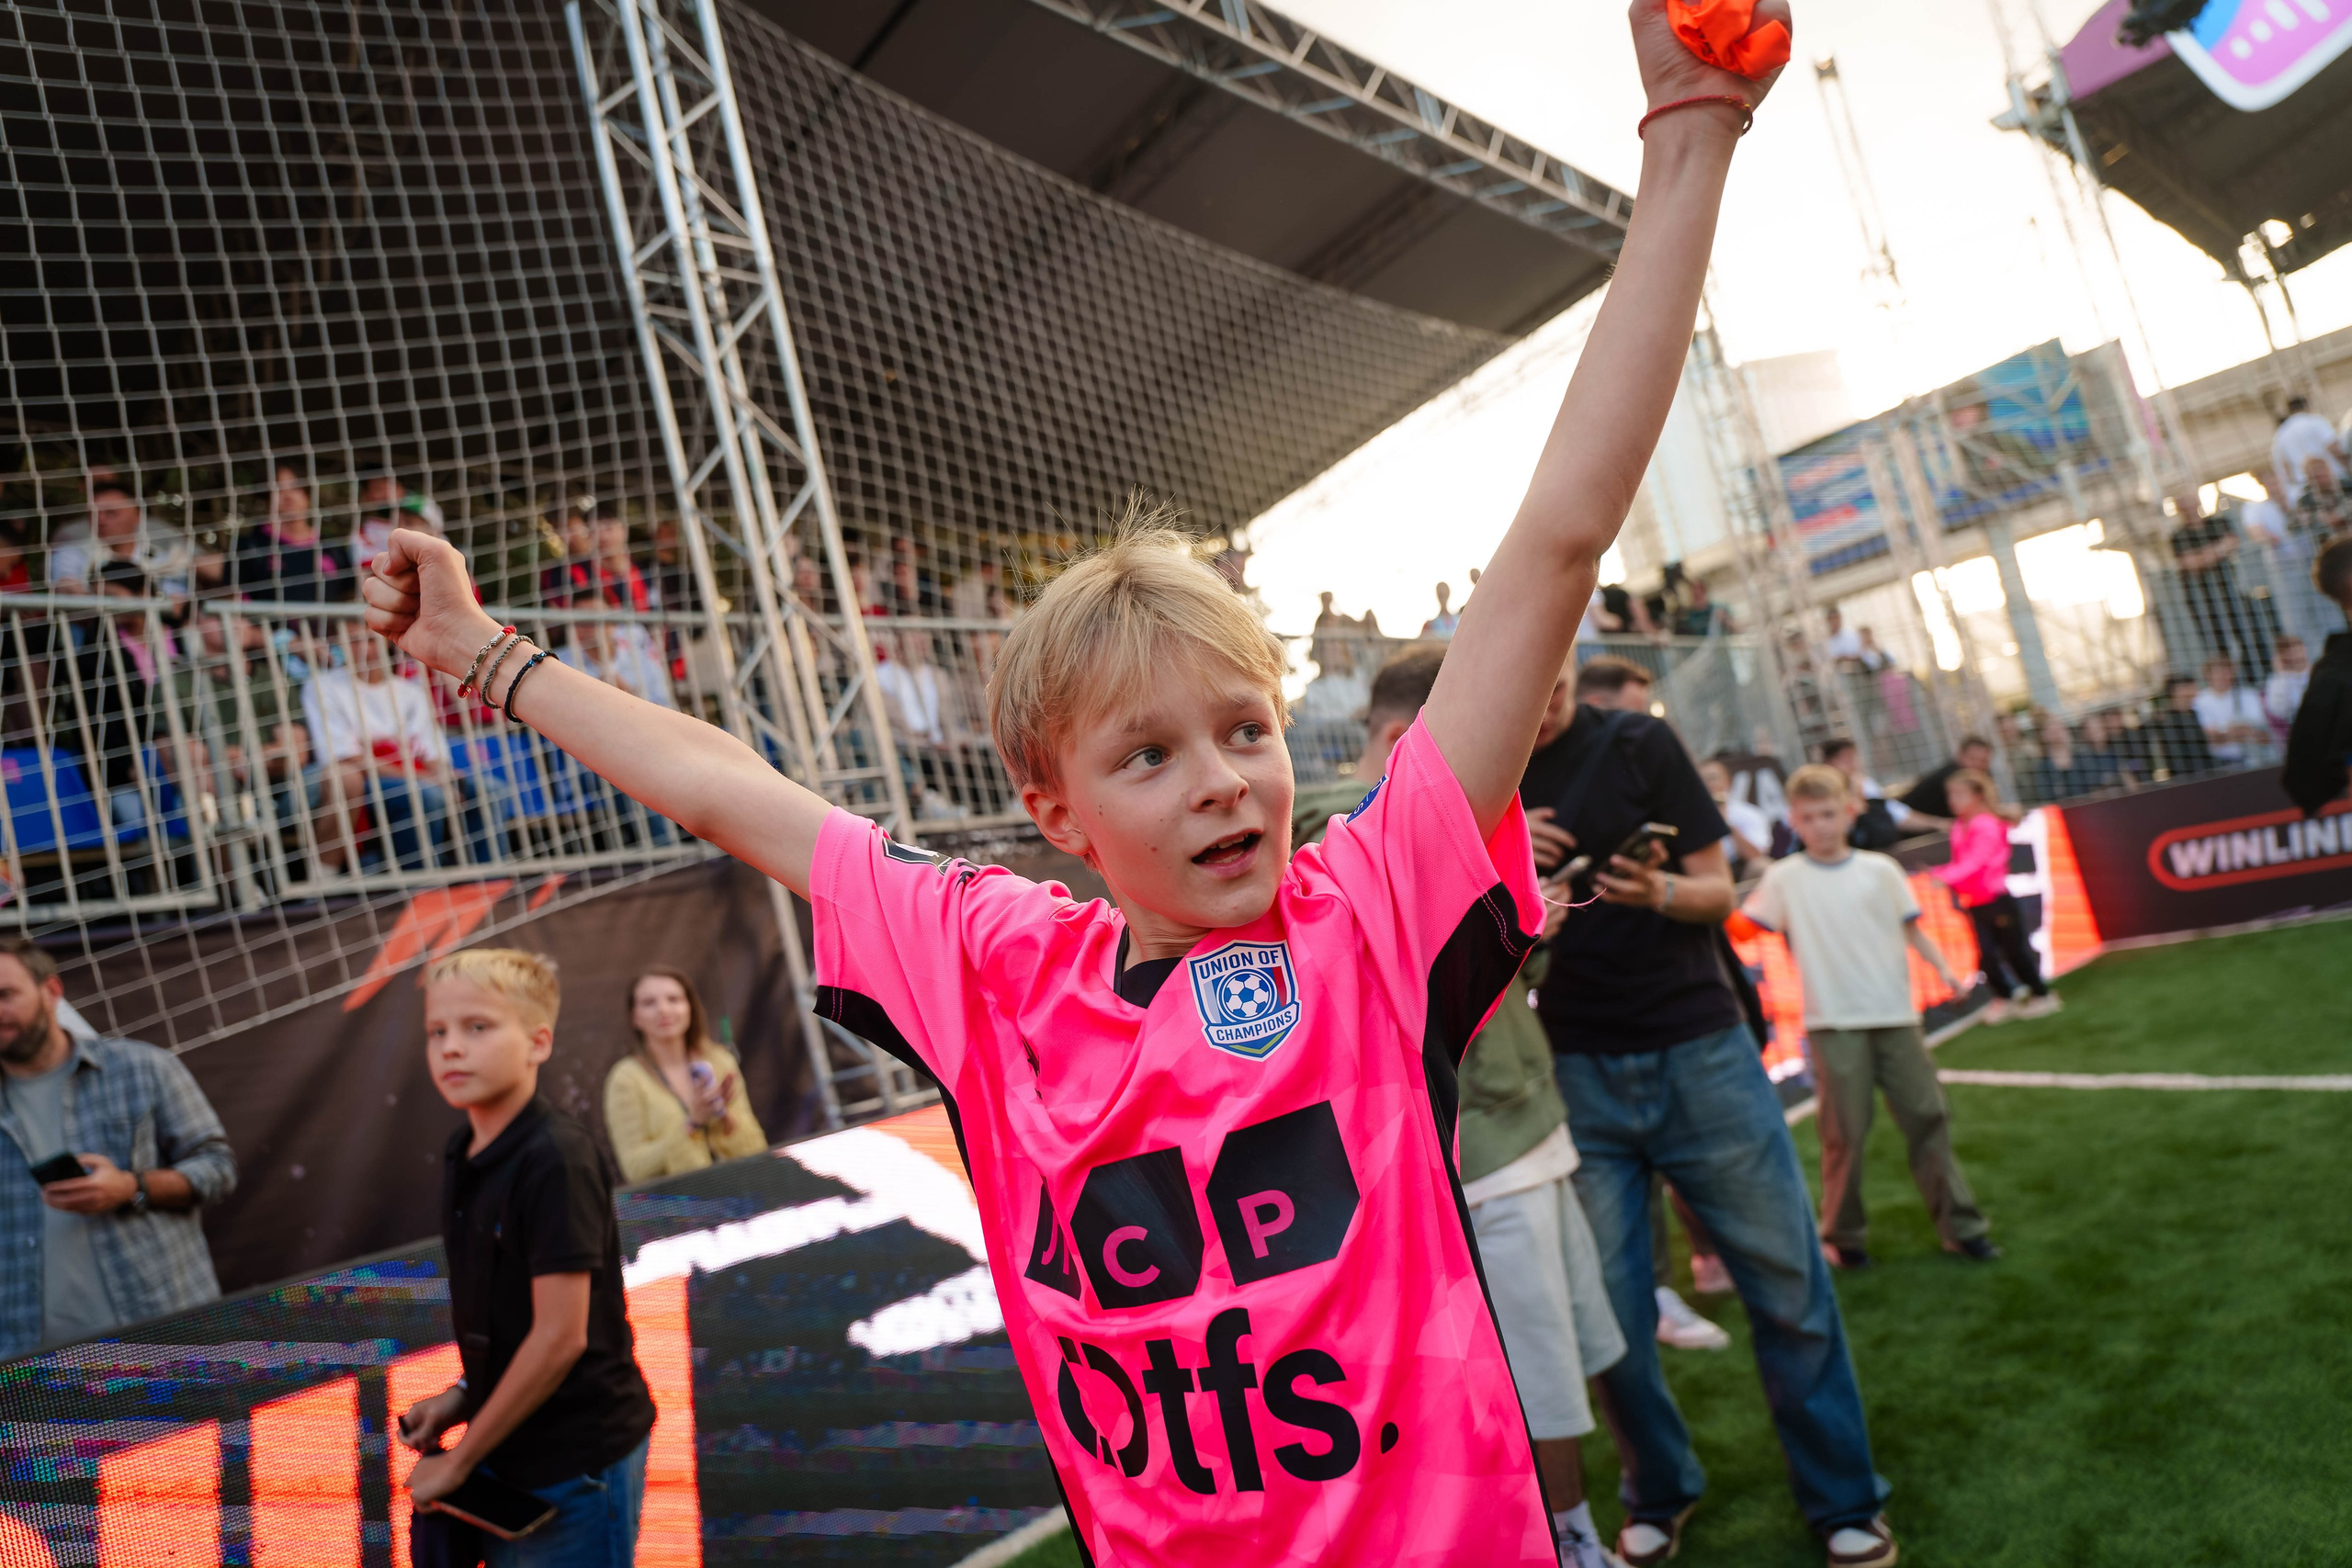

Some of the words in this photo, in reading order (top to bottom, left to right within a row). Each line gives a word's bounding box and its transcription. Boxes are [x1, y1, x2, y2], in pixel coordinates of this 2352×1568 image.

[1198, 951, 1254, 980] UNION
[1258, 949, 1279, 964] OF
[1216, 1010, 1293, 1042] CHAMPIONS
